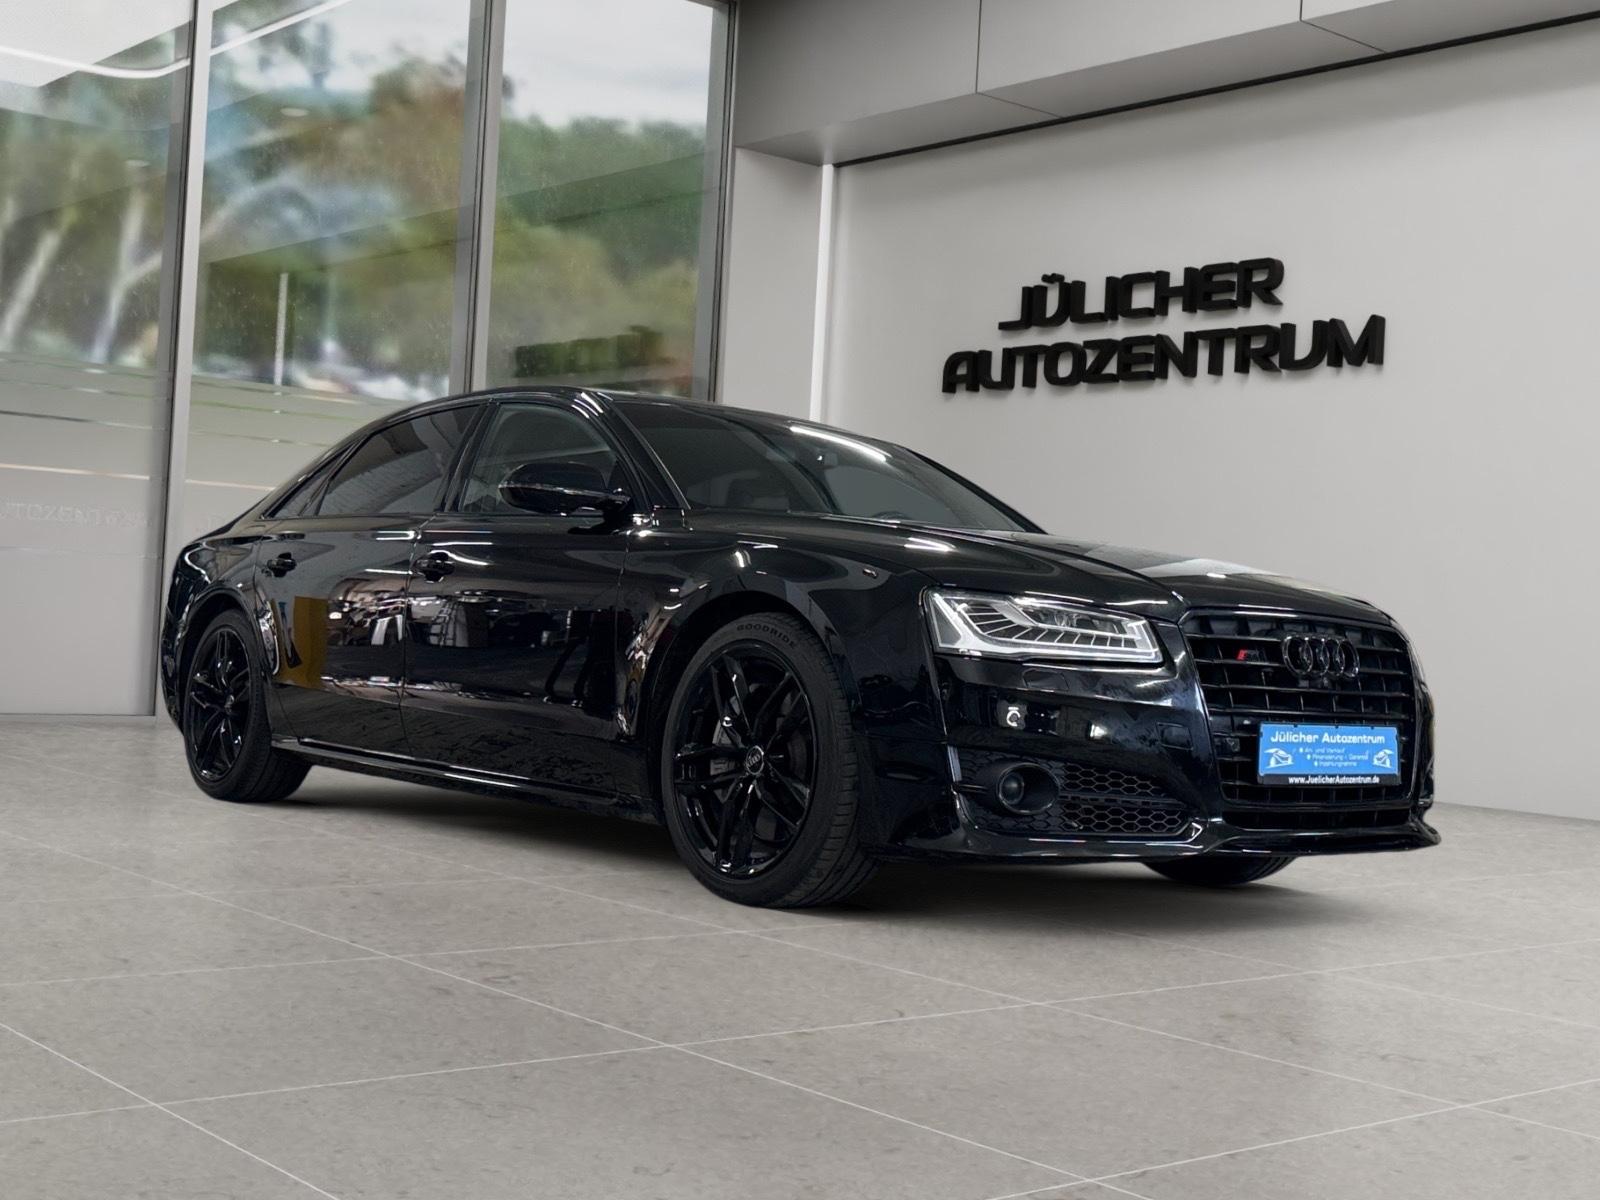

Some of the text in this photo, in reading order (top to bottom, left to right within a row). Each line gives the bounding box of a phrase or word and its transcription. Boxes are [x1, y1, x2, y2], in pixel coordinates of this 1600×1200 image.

[998, 257, 1285, 333] JÜLICHER
[942, 314, 1386, 394] AUTOZENTRUM
[1270, 731, 1385, 744] Jülicher Autozentrum
[1288, 774, 1380, 784] www.JuelicherAutozentrum.de
